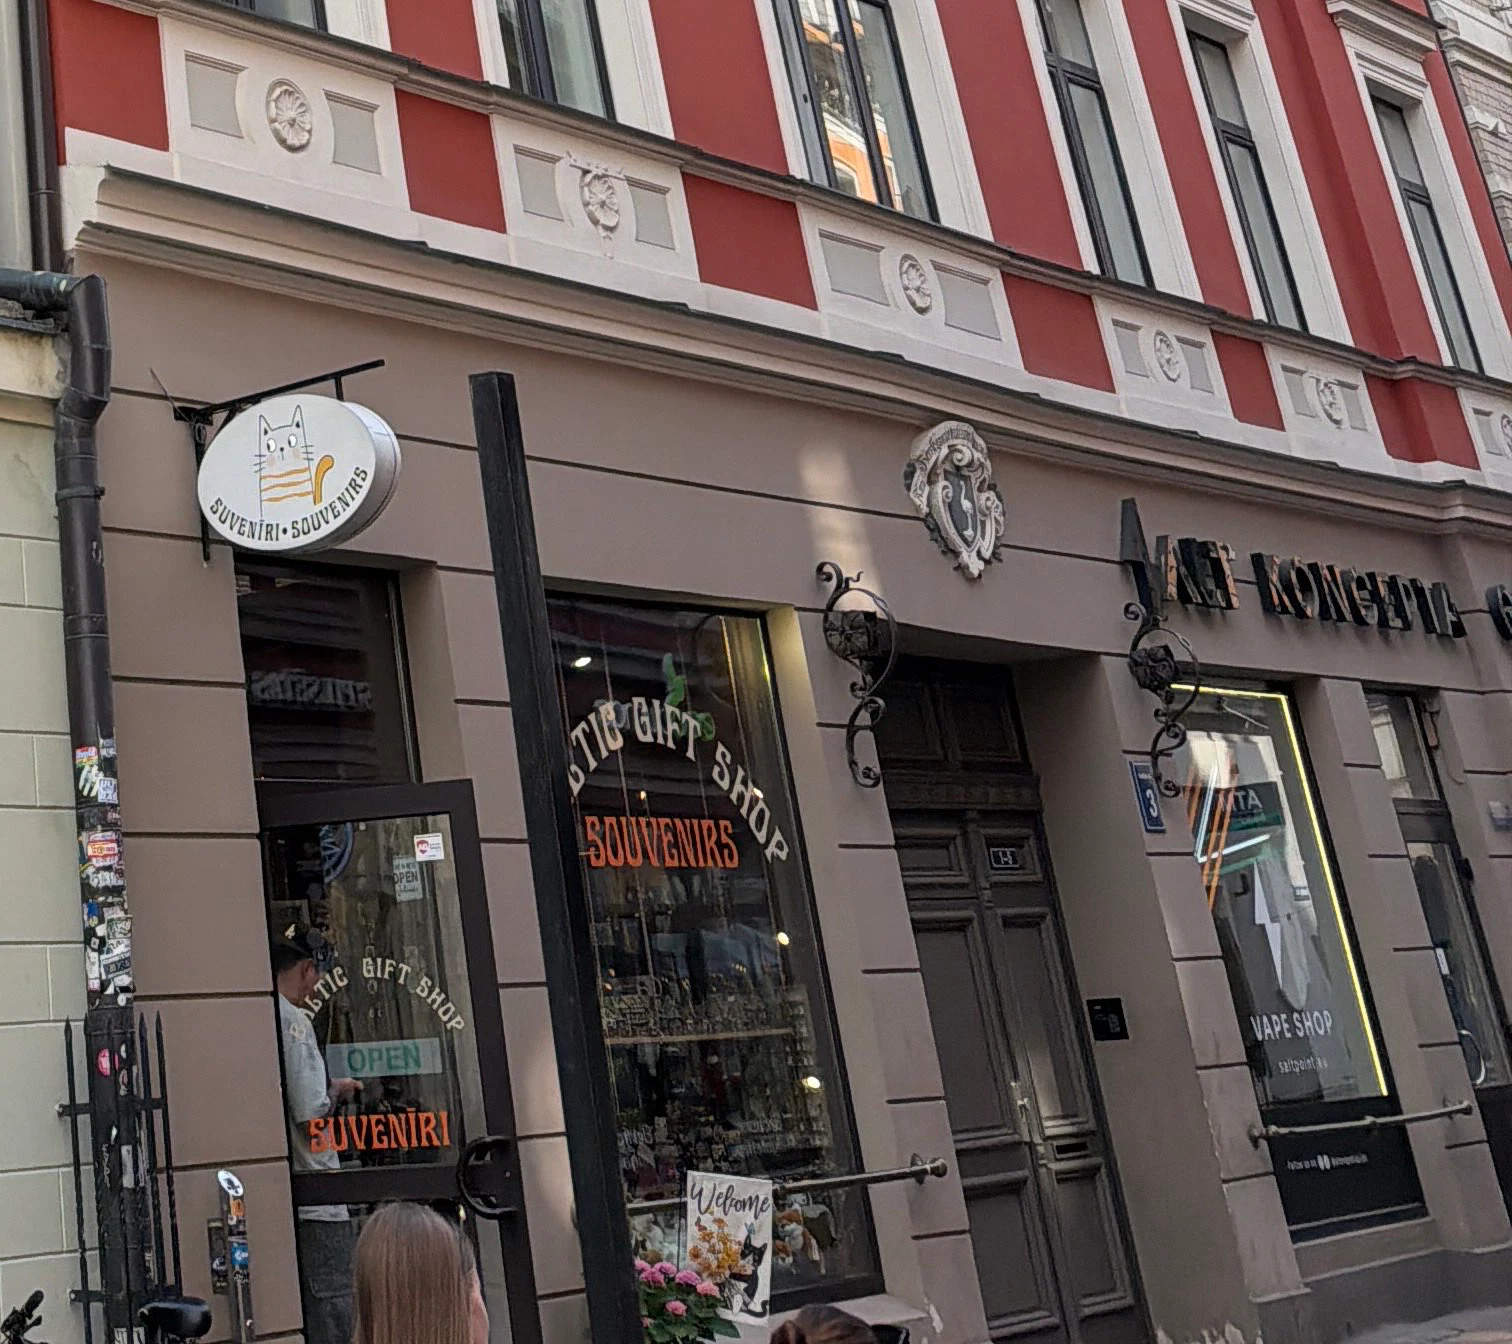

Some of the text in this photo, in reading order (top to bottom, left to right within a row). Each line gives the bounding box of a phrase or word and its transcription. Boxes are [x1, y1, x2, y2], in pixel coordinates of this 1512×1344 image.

[210, 466, 369, 542] SUVENĪRI SOUVENIRS
[631, 696, 702, 762] GIFT
[712, 740, 789, 864] SHOP
[1145, 788, 1158, 818] 3
[584, 815, 739, 868] SOUVENIRS
[362, 957, 412, 985] GIFT
[416, 975, 466, 1031] SHOP
[1250, 1010, 1333, 1042] VAPE SHOP
[347, 1042, 422, 1074] OPEN
[309, 1108, 451, 1153] SUVENĪRI
[690, 1182, 770, 1220] Welcome
